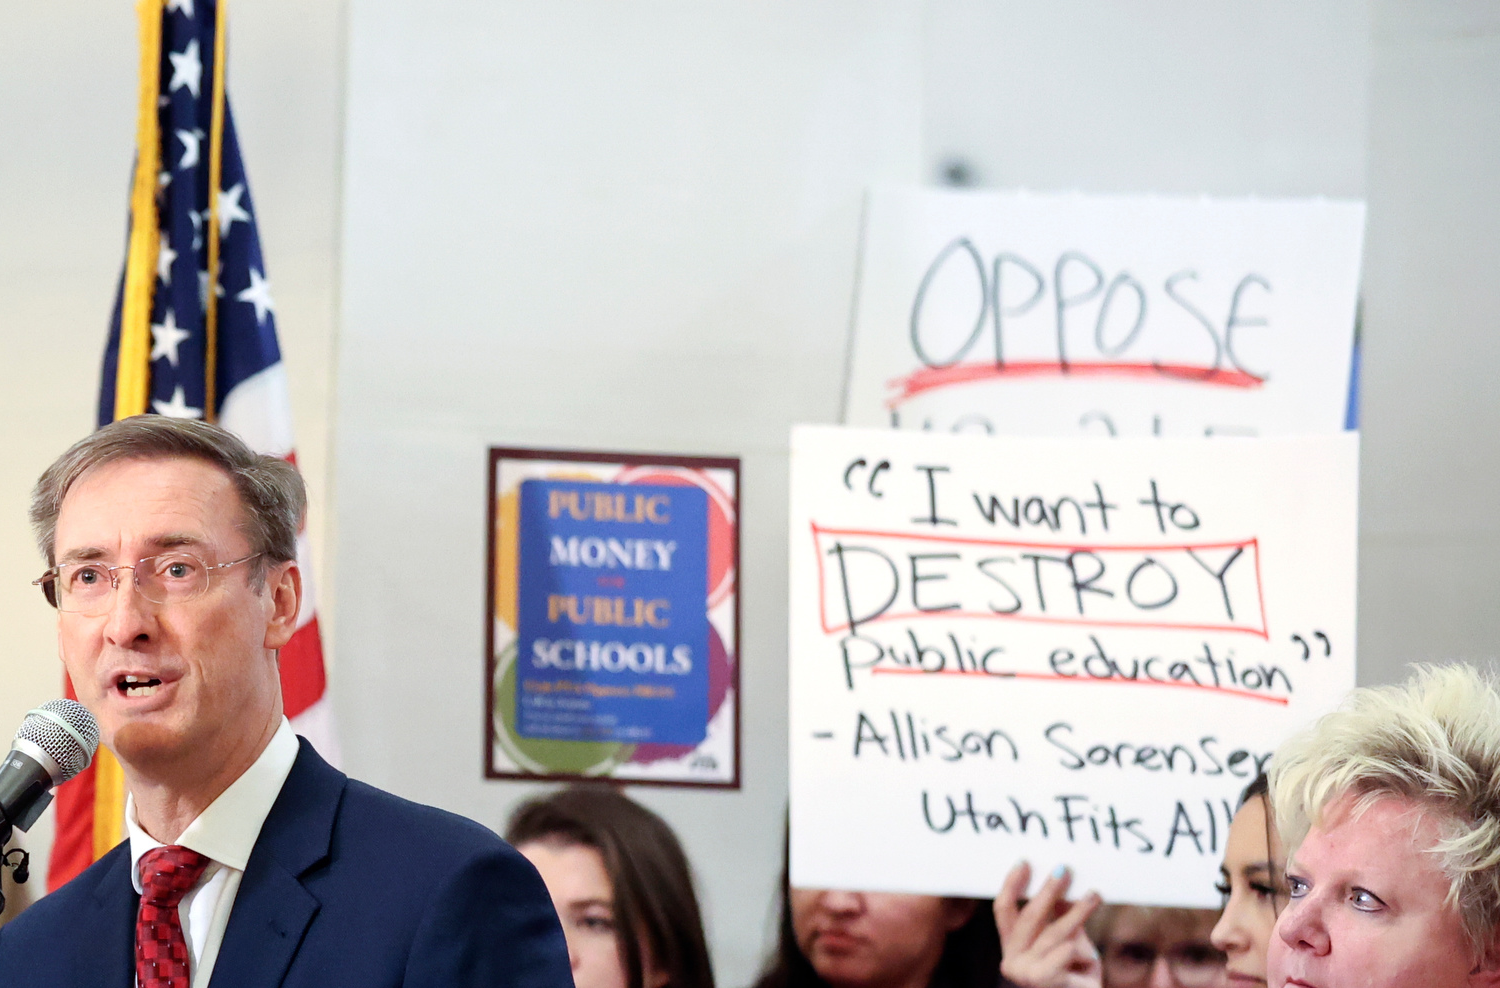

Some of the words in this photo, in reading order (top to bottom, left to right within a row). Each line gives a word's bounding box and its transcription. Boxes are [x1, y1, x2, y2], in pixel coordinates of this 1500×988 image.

[908, 235, 1272, 382] OPPOSE
[548, 489, 671, 524] PUBLIC
[972, 482, 1118, 535] want
[1138, 478, 1201, 533] to
[549, 535, 677, 571] MONEY
[547, 594, 671, 628] PUBLIC
[829, 541, 1244, 637] DESTROY
[531, 637, 694, 676] SCHOOLS
[853, 709, 1019, 762] Allison
